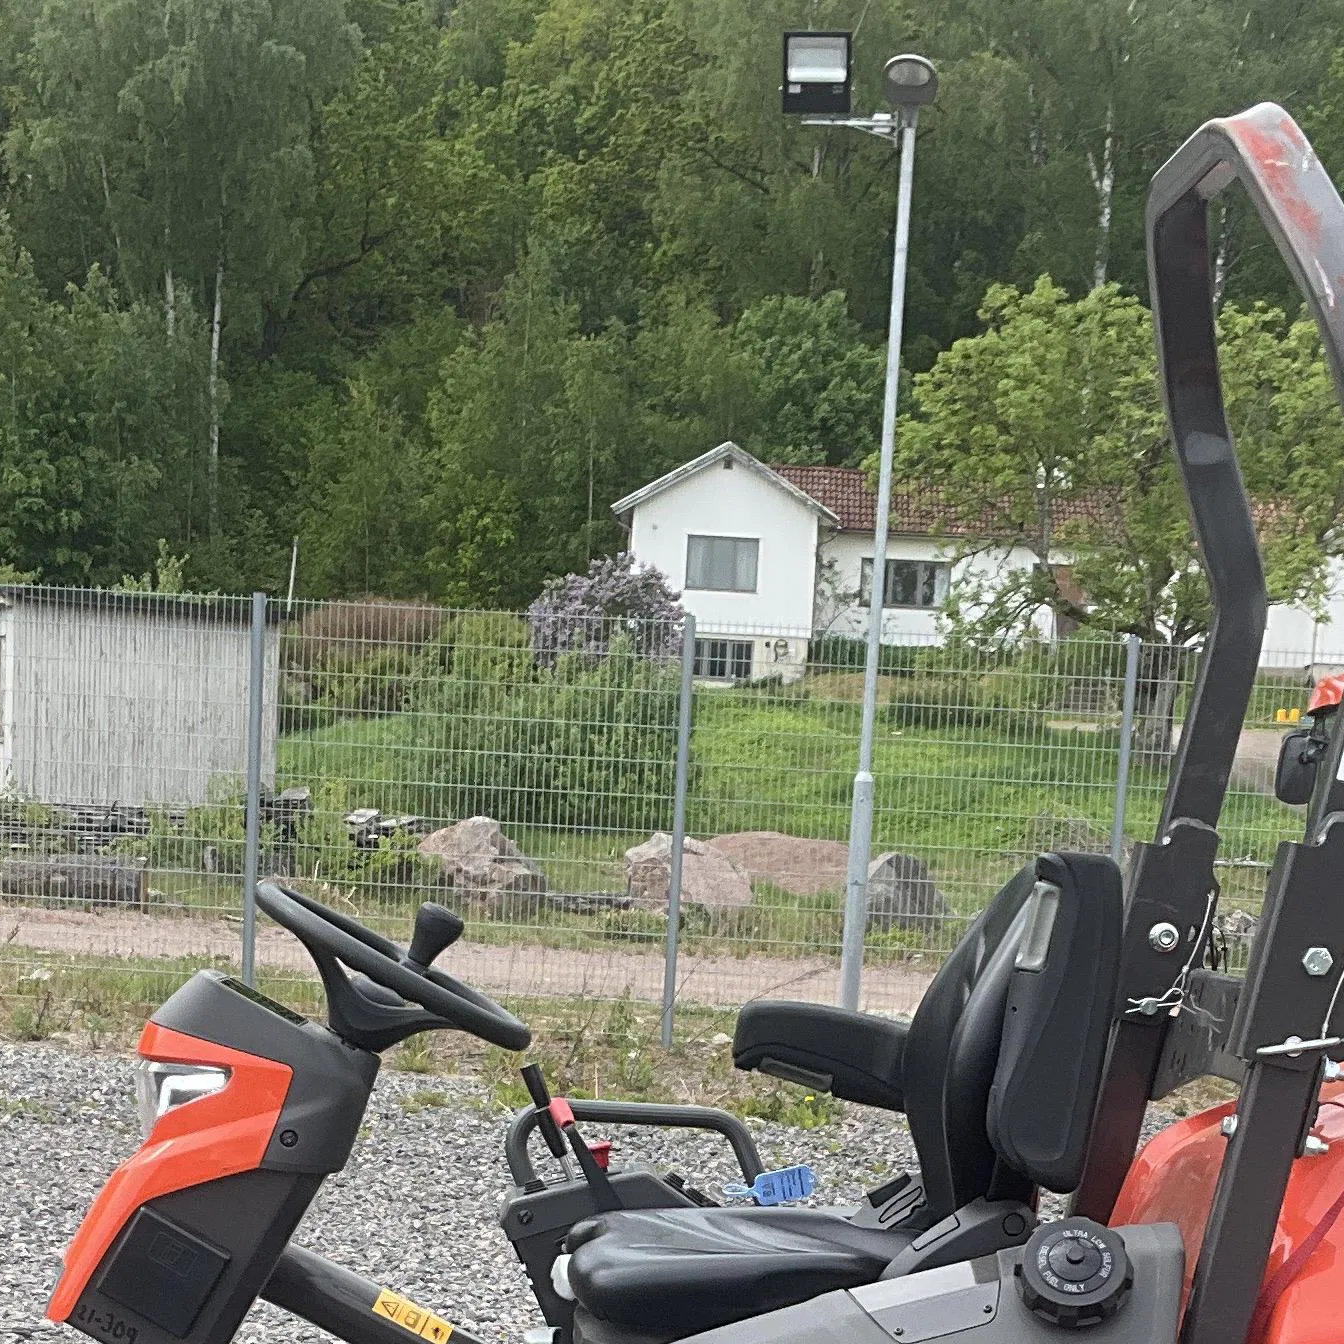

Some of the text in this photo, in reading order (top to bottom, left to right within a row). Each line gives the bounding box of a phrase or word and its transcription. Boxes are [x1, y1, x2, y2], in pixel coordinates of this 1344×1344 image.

[1062, 1229, 1088, 1238] ULTRA
[1091, 1235, 1106, 1249] LOW
[1043, 1270, 1060, 1288] FUEL
[1063, 1283, 1085, 1292] ONLY
